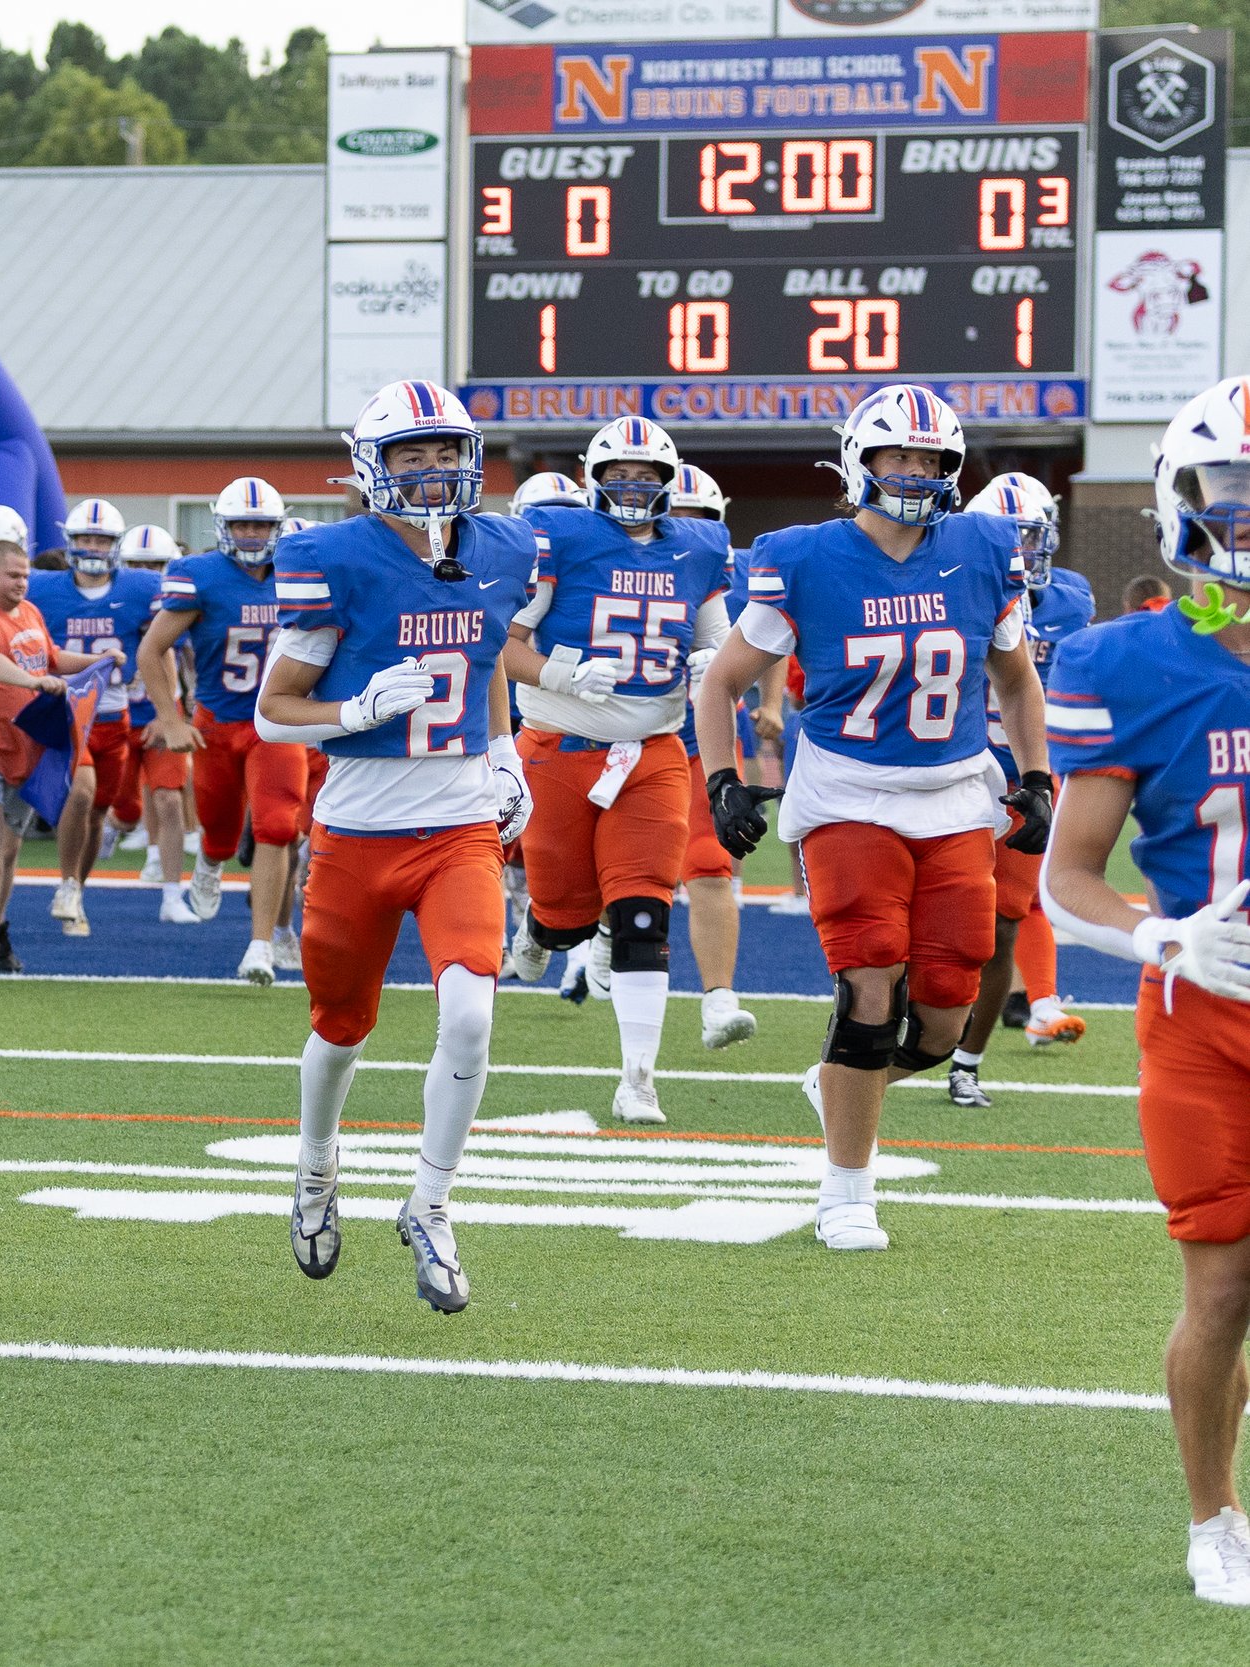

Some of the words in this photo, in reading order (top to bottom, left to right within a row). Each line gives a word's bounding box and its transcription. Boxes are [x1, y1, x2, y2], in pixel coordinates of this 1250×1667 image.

[564, 3, 671, 26] Chemical
[679, 3, 715, 24] Co.
[641, 59, 768, 82] NORTHWEST
[772, 56, 823, 80] HIGH
[826, 55, 906, 78] SCHOOL
[914, 46, 993, 115] N
[556, 55, 632, 123] N
[632, 86, 747, 118] BRUINS
[752, 83, 910, 117] FOOTBALL
[500, 146, 635, 180] GUEST
[900, 137, 1061, 173] BRUINS
[700, 140, 873, 213] 12:00
[481, 187, 512, 234] 3
[978, 178, 1026, 250] 0
[1038, 177, 1070, 225] 3
[566, 186, 611, 256] 0
[1030, 227, 1074, 248] TOL
[475, 235, 518, 256] TOL
[485, 272, 584, 299] DOWN
[637, 270, 680, 298] TO
[686, 270, 734, 298] GO
[783, 268, 868, 296] BALL
[878, 266, 928, 295] ON
[972, 266, 1049, 294] QTR.
[539, 304, 556, 373] 1
[668, 301, 730, 373] 10
[808, 299, 899, 371] 20
[1015, 297, 1032, 369] 1
[507, 386, 641, 418] BRUIN
[655, 383, 867, 418] COUNTRY
[948, 382, 1038, 416] 3FM
[908, 435, 942, 445] Riddell
[612, 569, 675, 597] BRUINS
[66, 617, 115, 636] BRUINS
[241, 604, 279, 624] BRUI
[863, 592, 947, 627] BRUINS
[398, 610, 484, 646] BRUINS
[591, 596, 687, 685] 55
[840, 628, 966, 742] 78
[406, 649, 471, 758] 2
